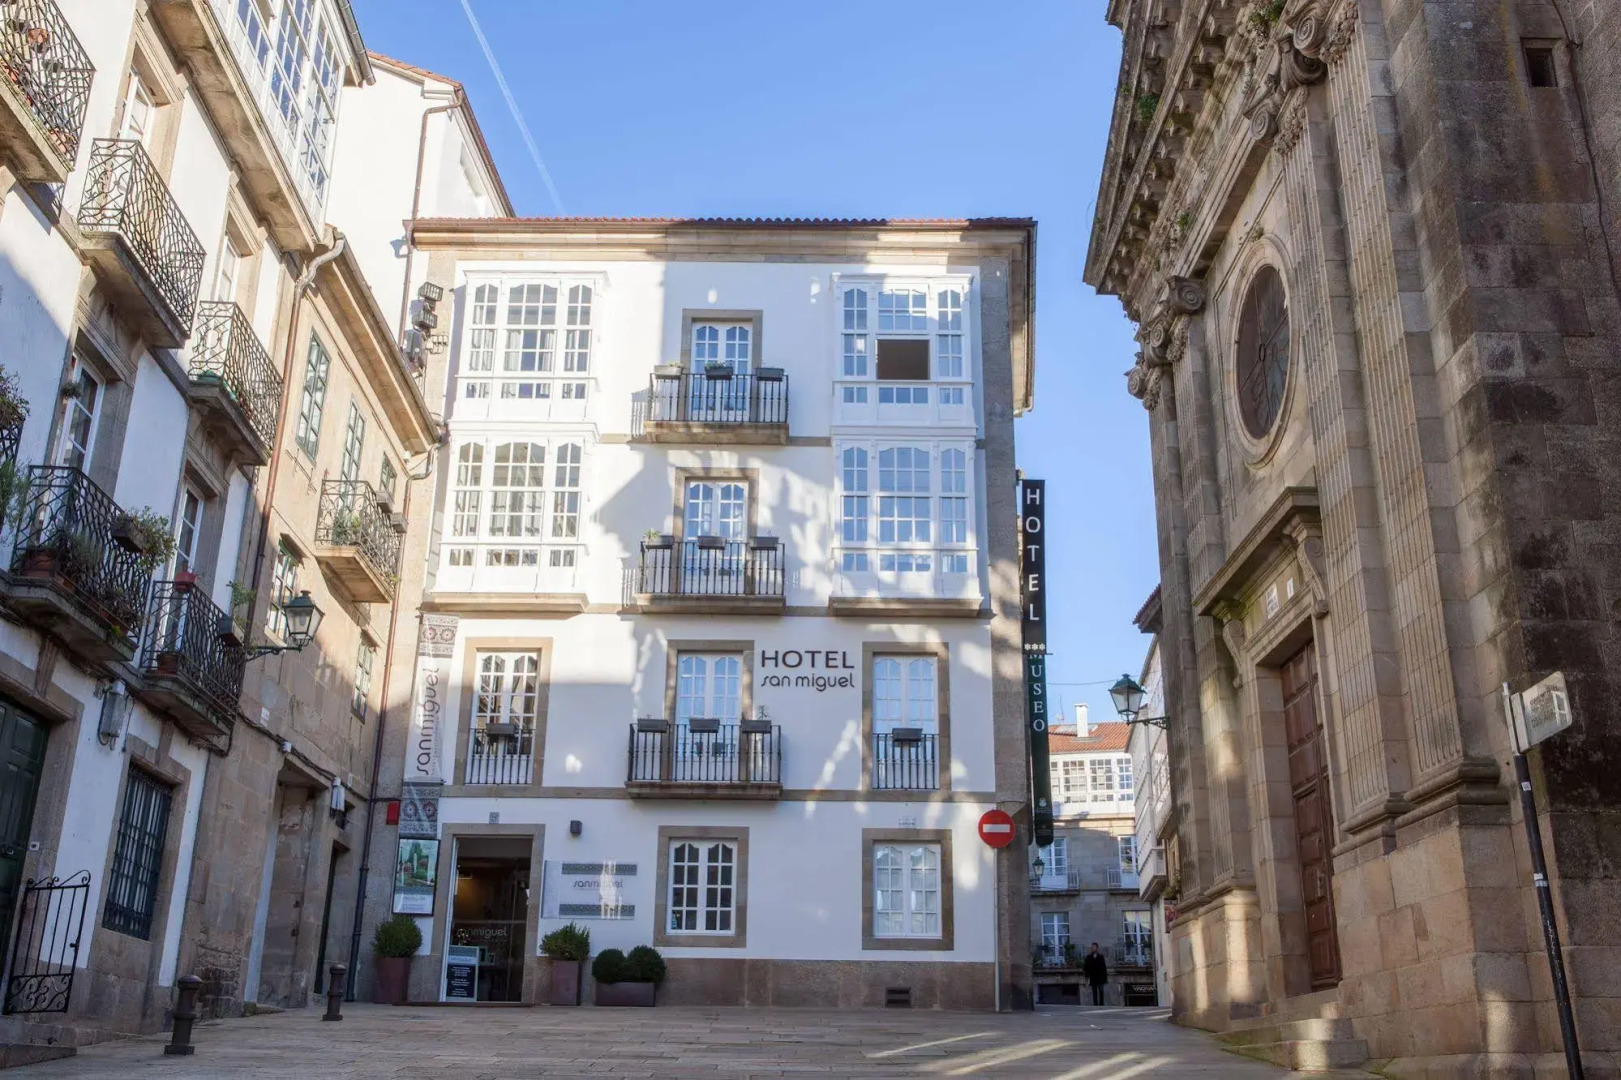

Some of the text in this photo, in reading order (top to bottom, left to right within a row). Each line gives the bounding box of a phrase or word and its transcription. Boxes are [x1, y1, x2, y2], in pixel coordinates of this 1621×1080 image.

[1026, 488, 1041, 621] HOTEL
[761, 650, 855, 669] HOTEL
[795, 671, 855, 692] miguel
